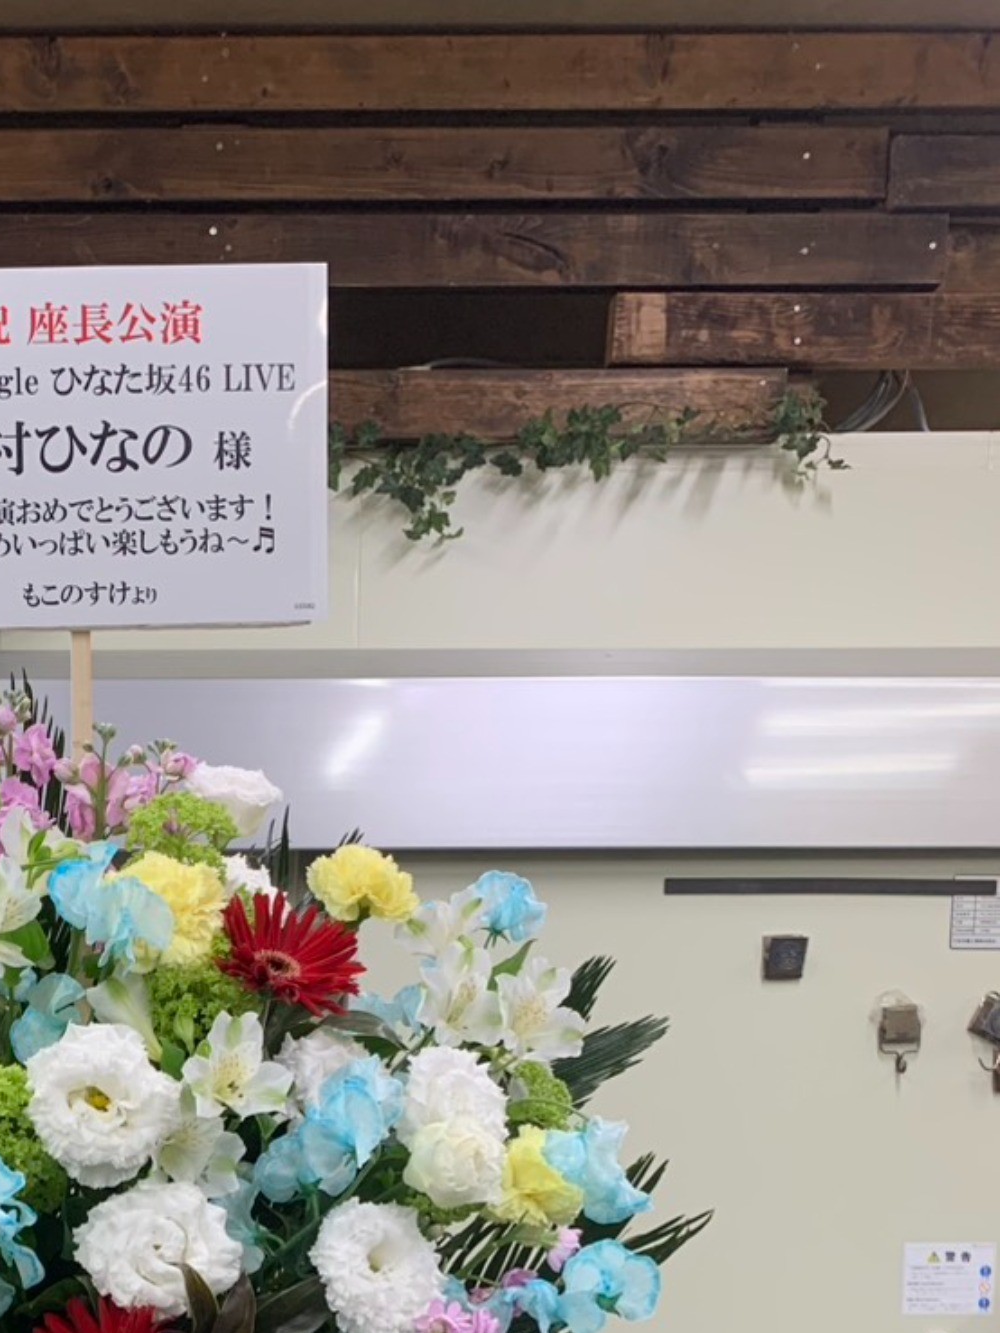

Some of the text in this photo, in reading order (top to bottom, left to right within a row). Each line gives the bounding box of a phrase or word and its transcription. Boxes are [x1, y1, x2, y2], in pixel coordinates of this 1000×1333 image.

[27, 299, 203, 346] 座長公演
[50, 362, 211, 397] ひなた坂46
[223, 362, 296, 393] LIVE
[213, 430, 252, 471] 様
[22, 580, 158, 608] もこのすけより
